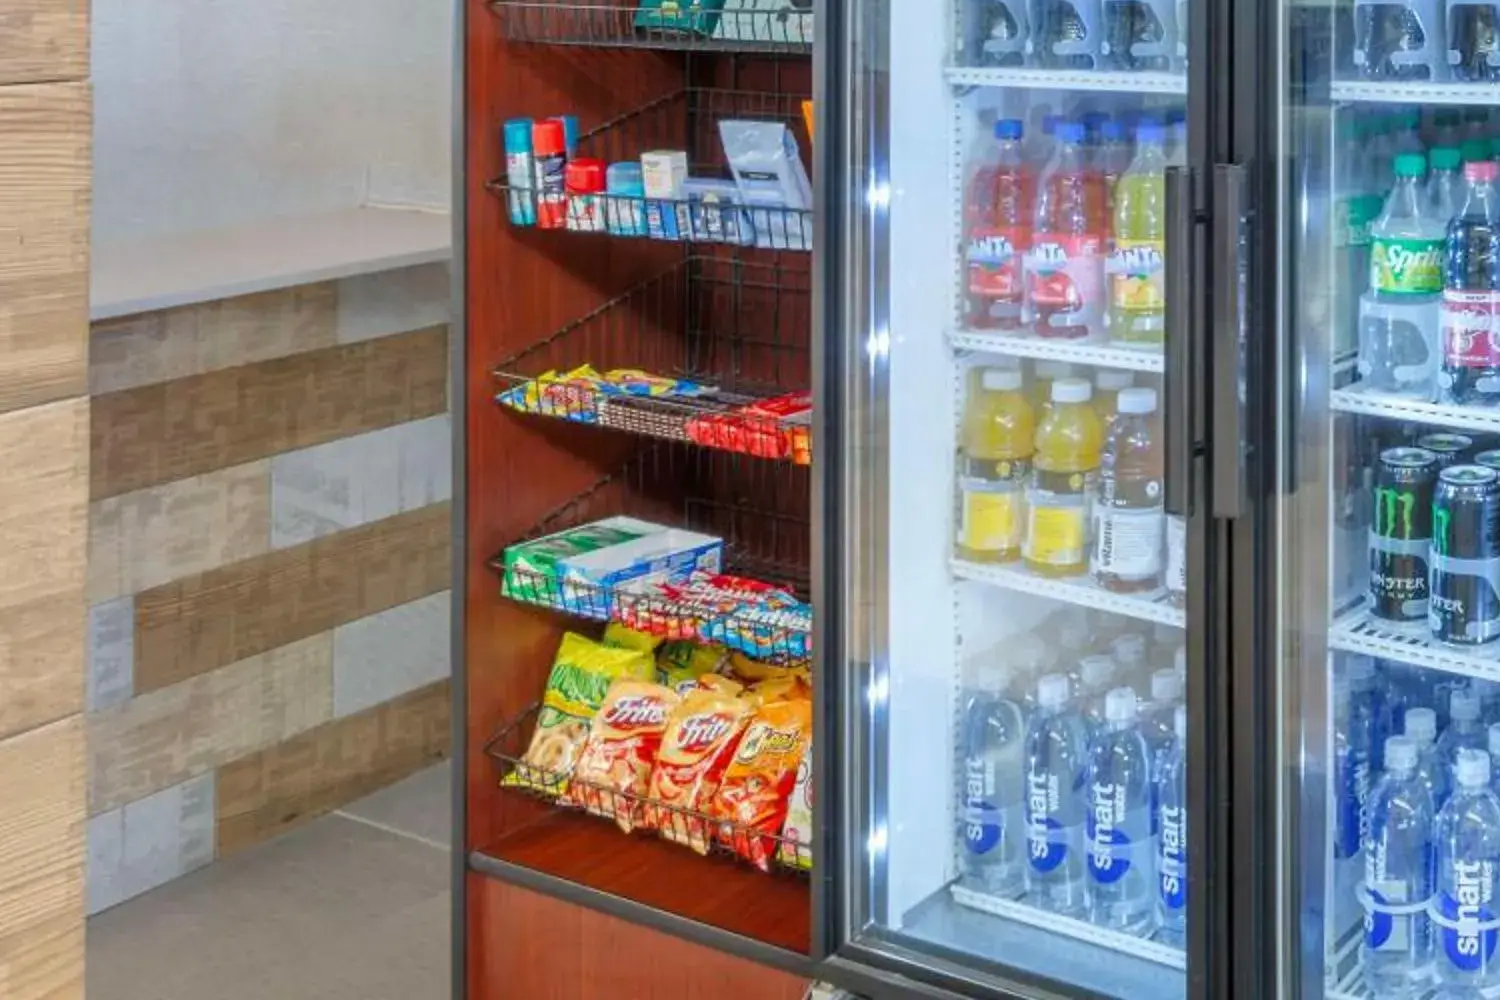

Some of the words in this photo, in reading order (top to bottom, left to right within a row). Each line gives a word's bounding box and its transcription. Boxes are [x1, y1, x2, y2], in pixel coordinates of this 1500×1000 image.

[965, 755, 985, 841] smart
[1028, 768, 1048, 860] smart
[1091, 781, 1114, 871] smart
[1160, 804, 1181, 896] smart
